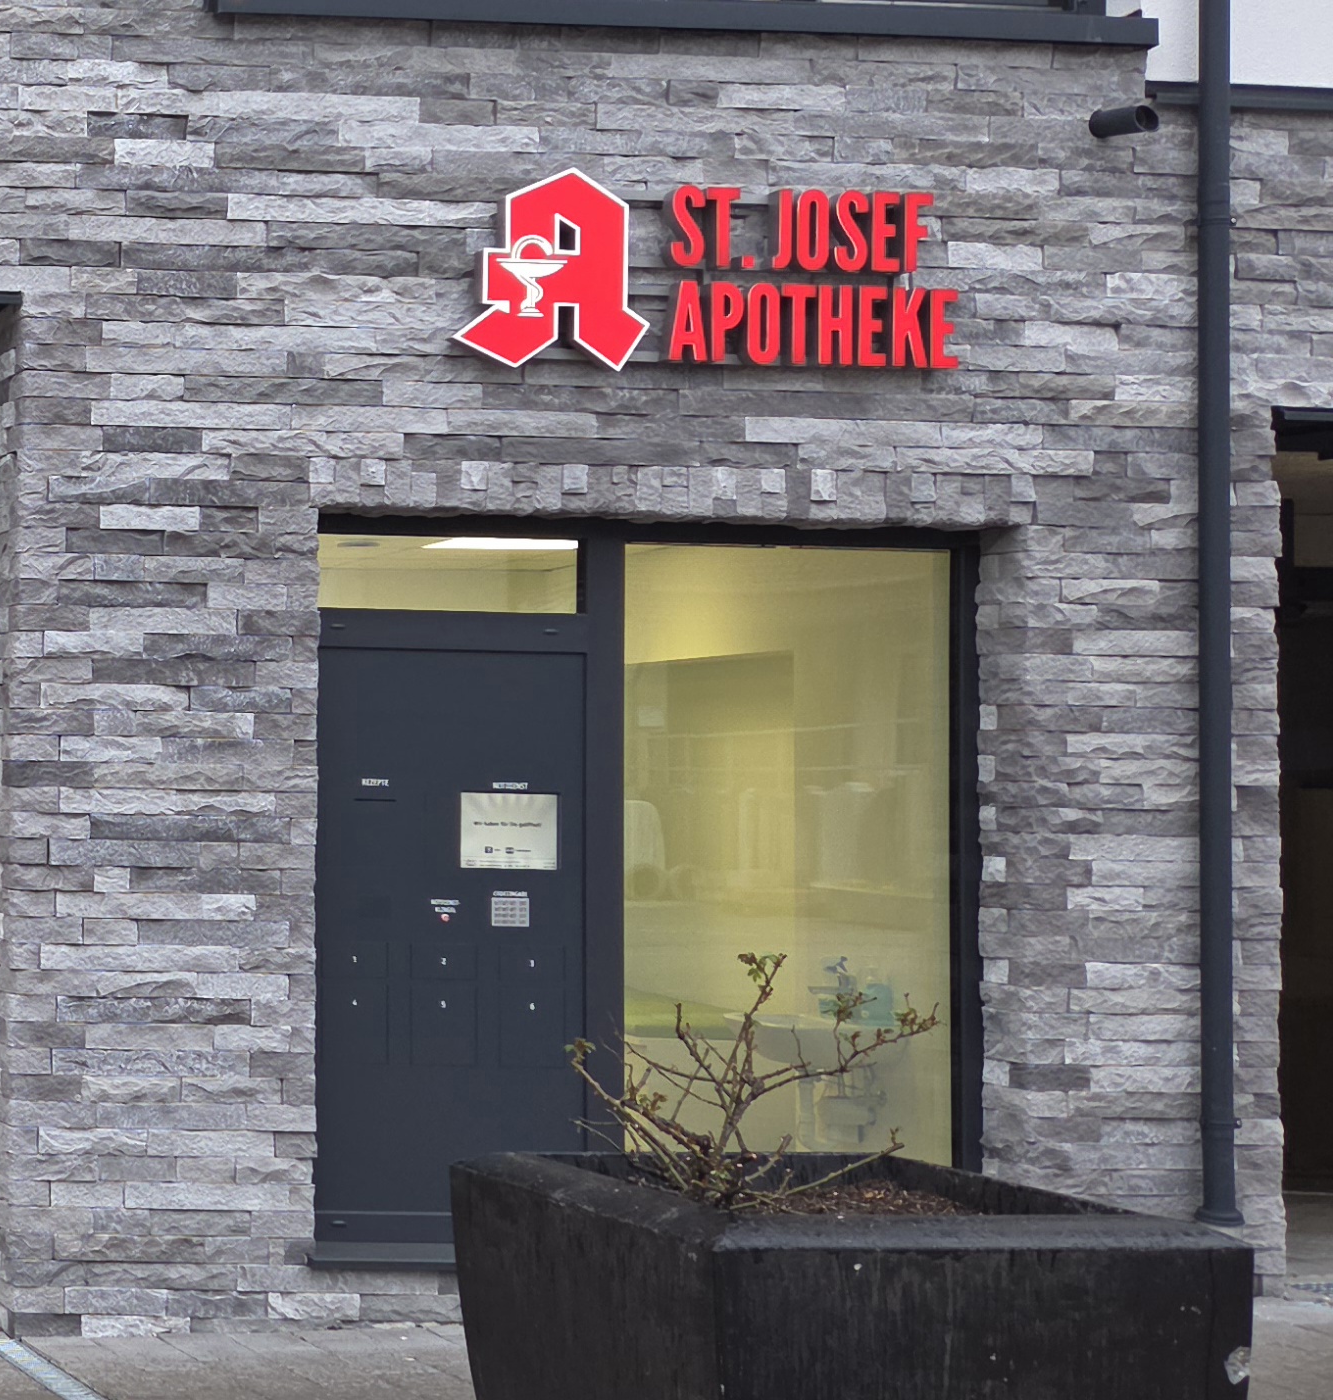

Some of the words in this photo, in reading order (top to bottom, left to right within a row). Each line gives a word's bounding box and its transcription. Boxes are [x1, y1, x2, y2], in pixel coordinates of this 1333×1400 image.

[668, 184, 755, 270] ST.
[771, 188, 935, 273] JOSEF
[667, 280, 959, 369] APOTHEKE
